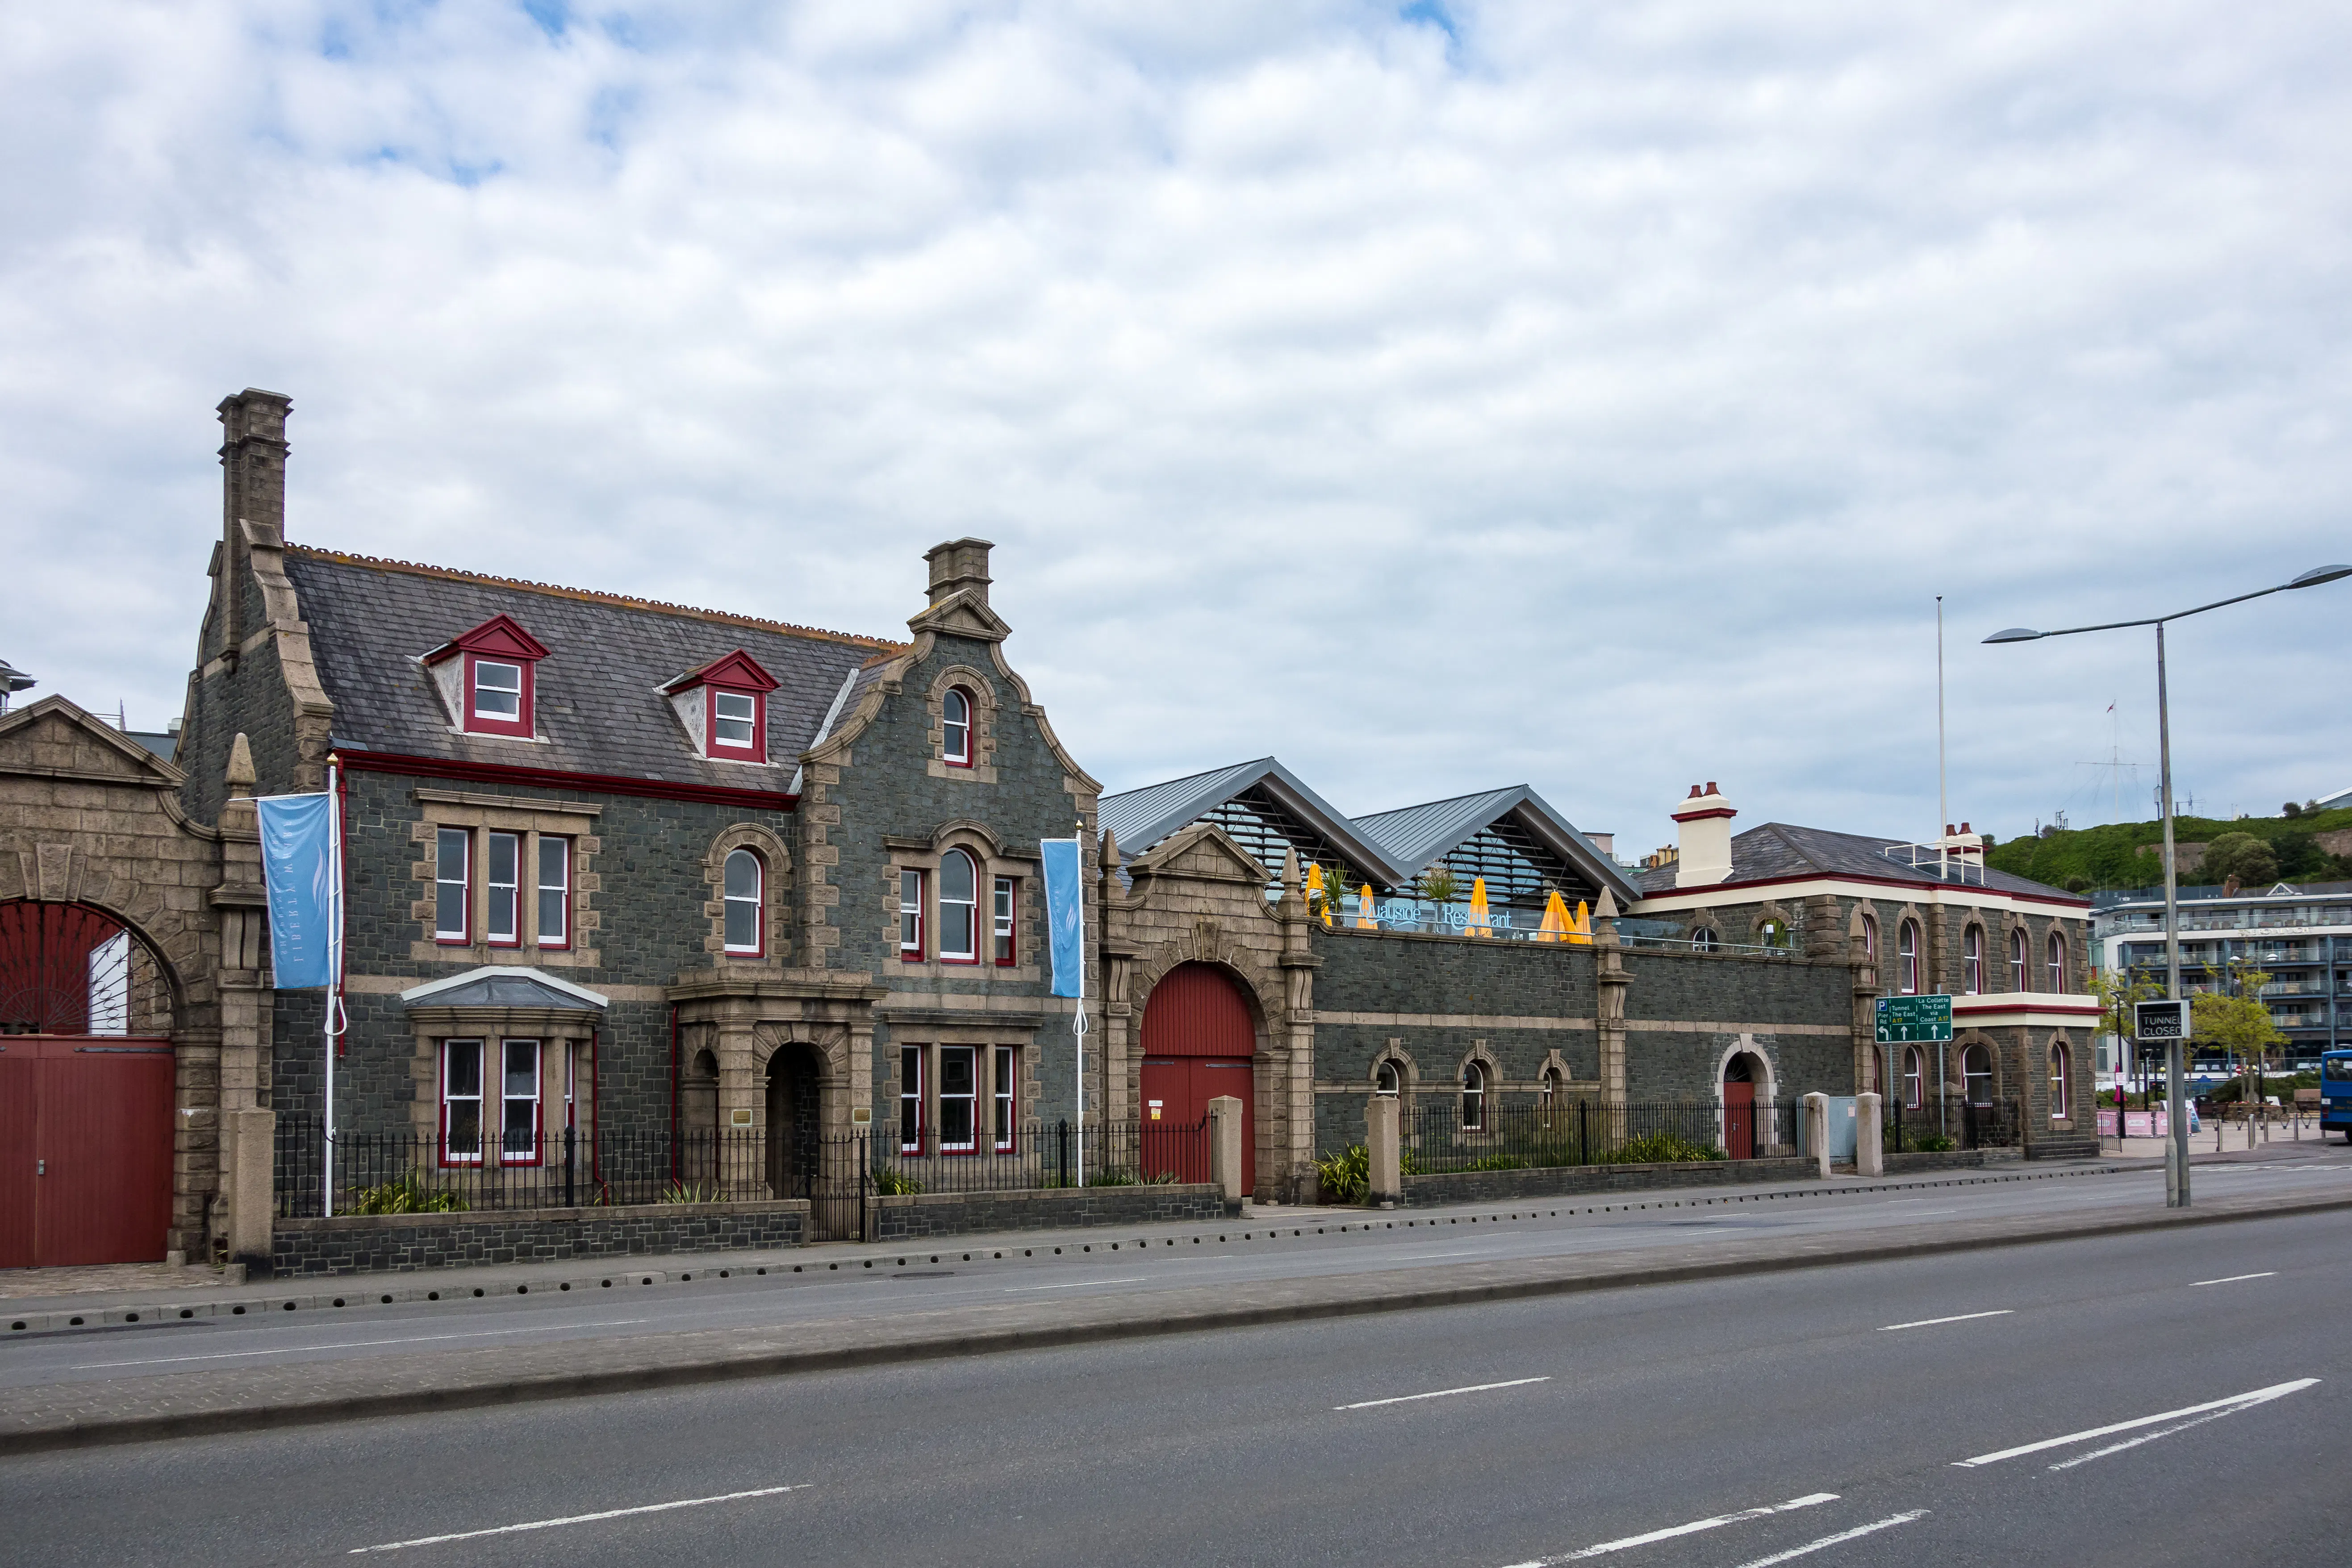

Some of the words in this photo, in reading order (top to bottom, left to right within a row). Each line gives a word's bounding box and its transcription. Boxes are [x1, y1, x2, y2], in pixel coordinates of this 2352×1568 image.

[1359, 896, 1421, 926] Quayside
[1443, 903, 1512, 931] Restaurant
[1879, 1001, 1885, 1010] P
[2143, 1016, 2181, 1024] TUNNEL
[2143, 1026, 2182, 1036] CLOSED
